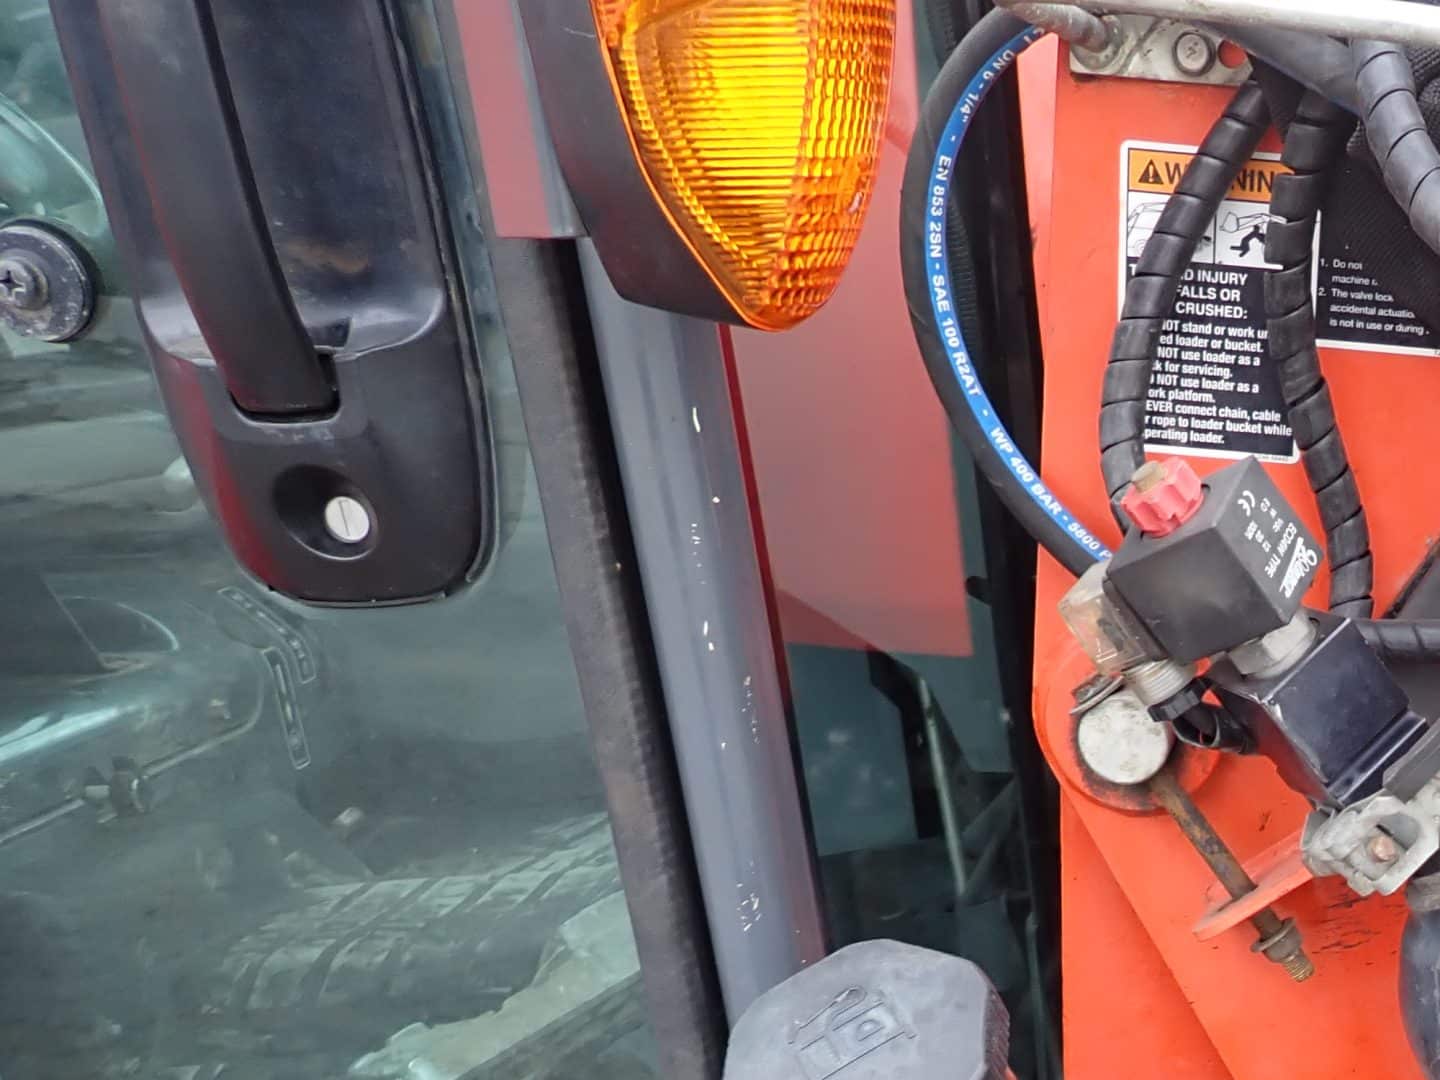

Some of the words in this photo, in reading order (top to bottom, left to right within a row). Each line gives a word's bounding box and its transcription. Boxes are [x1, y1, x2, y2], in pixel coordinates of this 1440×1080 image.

[993, 50, 1014, 72] DN
[936, 155, 952, 181] EN
[1164, 161, 1273, 194] WNIN
[931, 185, 946, 217] 853
[929, 221, 943, 259] 2SN
[1332, 258, 1347, 269] Do
[1197, 270, 1248, 286] INJURY
[1331, 274, 1370, 286] machine
[932, 275, 950, 313] SAE
[1219, 288, 1241, 302] OR
[1331, 288, 1349, 299] The
[1350, 289, 1374, 301] valve
[1175, 302, 1248, 320] CRUSHED:
[1329, 303, 1377, 316] accidental
[1377, 308, 1416, 319] actuatio
[942, 318, 960, 348] 100
[1181, 321, 1212, 335] stand
[1214, 324, 1226, 335] or
[1227, 325, 1255, 338] work
[1329, 318, 1338, 327] is
[1339, 318, 1354, 328] not
[1356, 319, 1365, 330] in
[1366, 322, 1382, 331] use
[1384, 323, 1394, 332] or
[1395, 323, 1425, 336] during
[1175, 335, 1208, 348] loader
[1210, 338, 1222, 349] or
[1224, 338, 1264, 353] bucket.
[1157, 347, 1180, 360] NOT
[1181, 350, 1201, 361] use
[1202, 350, 1236, 365] loader
[1238, 354, 1251, 366] as
[1253, 356, 1261, 366] a
[953, 351, 982, 396] R2AT
[1164, 361, 1179, 373] for
[1181, 363, 1233, 380] servicing.
[1156, 374, 1178, 387] NOT
[1180, 377, 1200, 389] use
[1201, 378, 1236, 392] loader
[1237, 382, 1250, 393] as
[1252, 383, 1260, 394] a
[1147, 388, 1167, 399] ork
[1168, 388, 1216, 404] platform.
[1145, 400, 1173, 413] EVER
[1175, 403, 1217, 417] connect
[1218, 406, 1250, 421] chain,
[1252, 409, 1281, 422] cable
[1152, 415, 1176, 428] rope
[1178, 416, 1189, 427] to
[1190, 417, 1224, 431] loader
[1226, 419, 1262, 434] bucket
[1263, 424, 1293, 437] while
[991, 427, 1014, 453] WP
[1143, 428, 1188, 444] perating
[1189, 430, 1225, 444] loader.
[1010, 457, 1034, 483] 400
[1031, 483, 1062, 516] BAR
